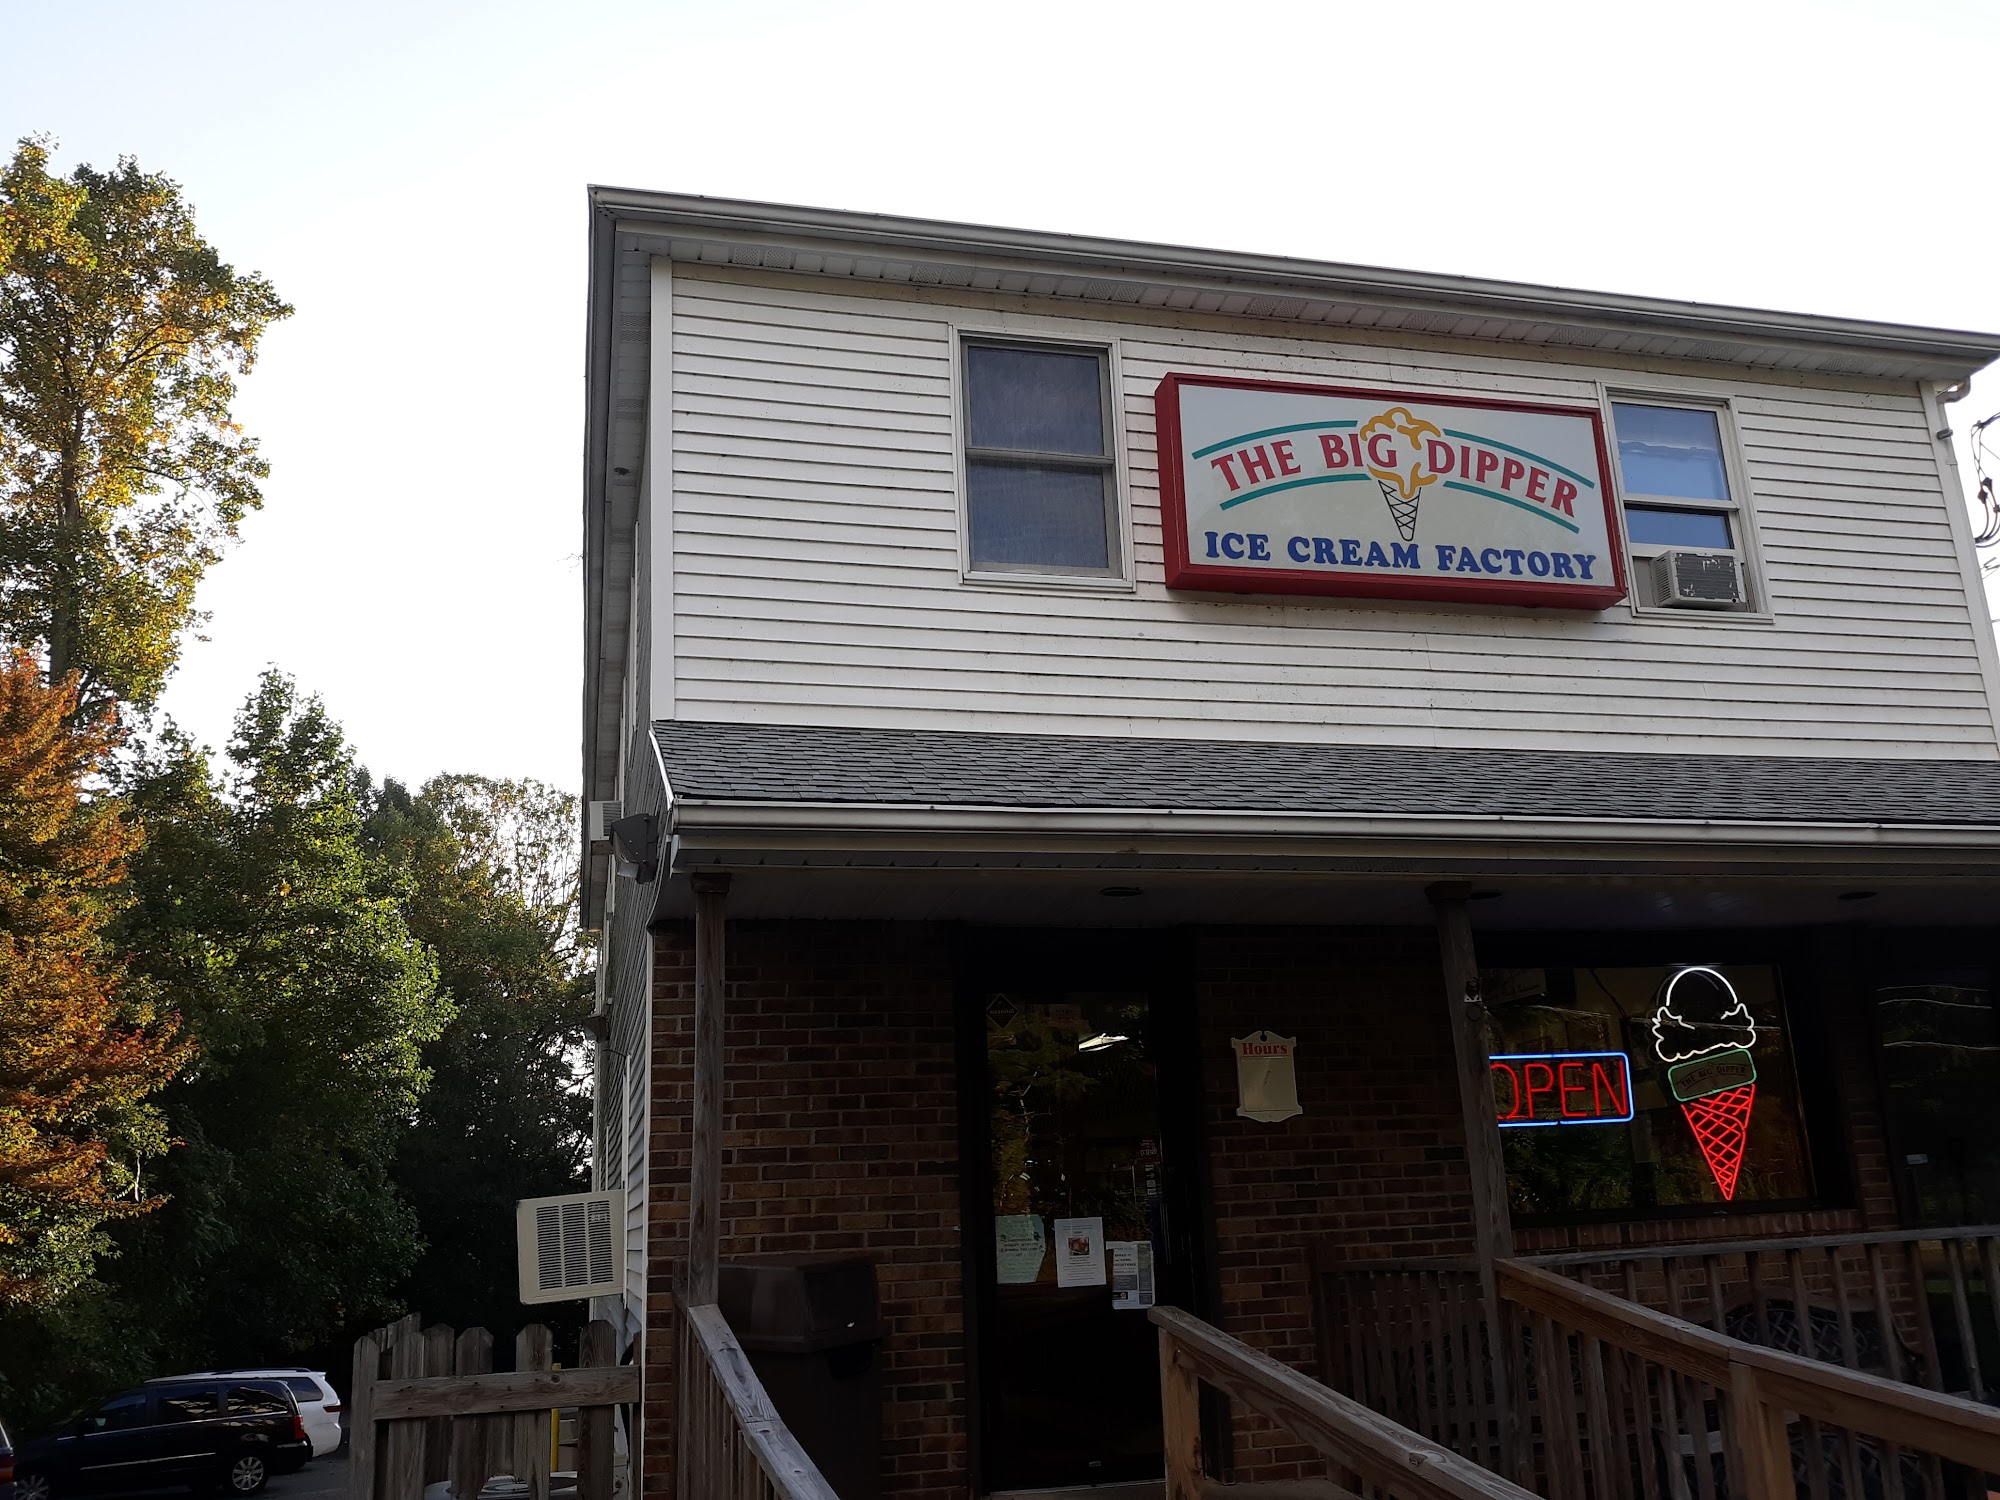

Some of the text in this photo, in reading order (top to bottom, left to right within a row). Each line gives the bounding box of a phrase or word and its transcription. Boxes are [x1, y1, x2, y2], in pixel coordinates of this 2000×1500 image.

[1210, 433, 1580, 519] THE BIG DIPPER
[1204, 530, 1598, 581] ICE CREAM FACTORY
[1241, 1042, 1289, 1056] Hours
[1681, 1065, 1747, 1088] THE BIG DIPPER
